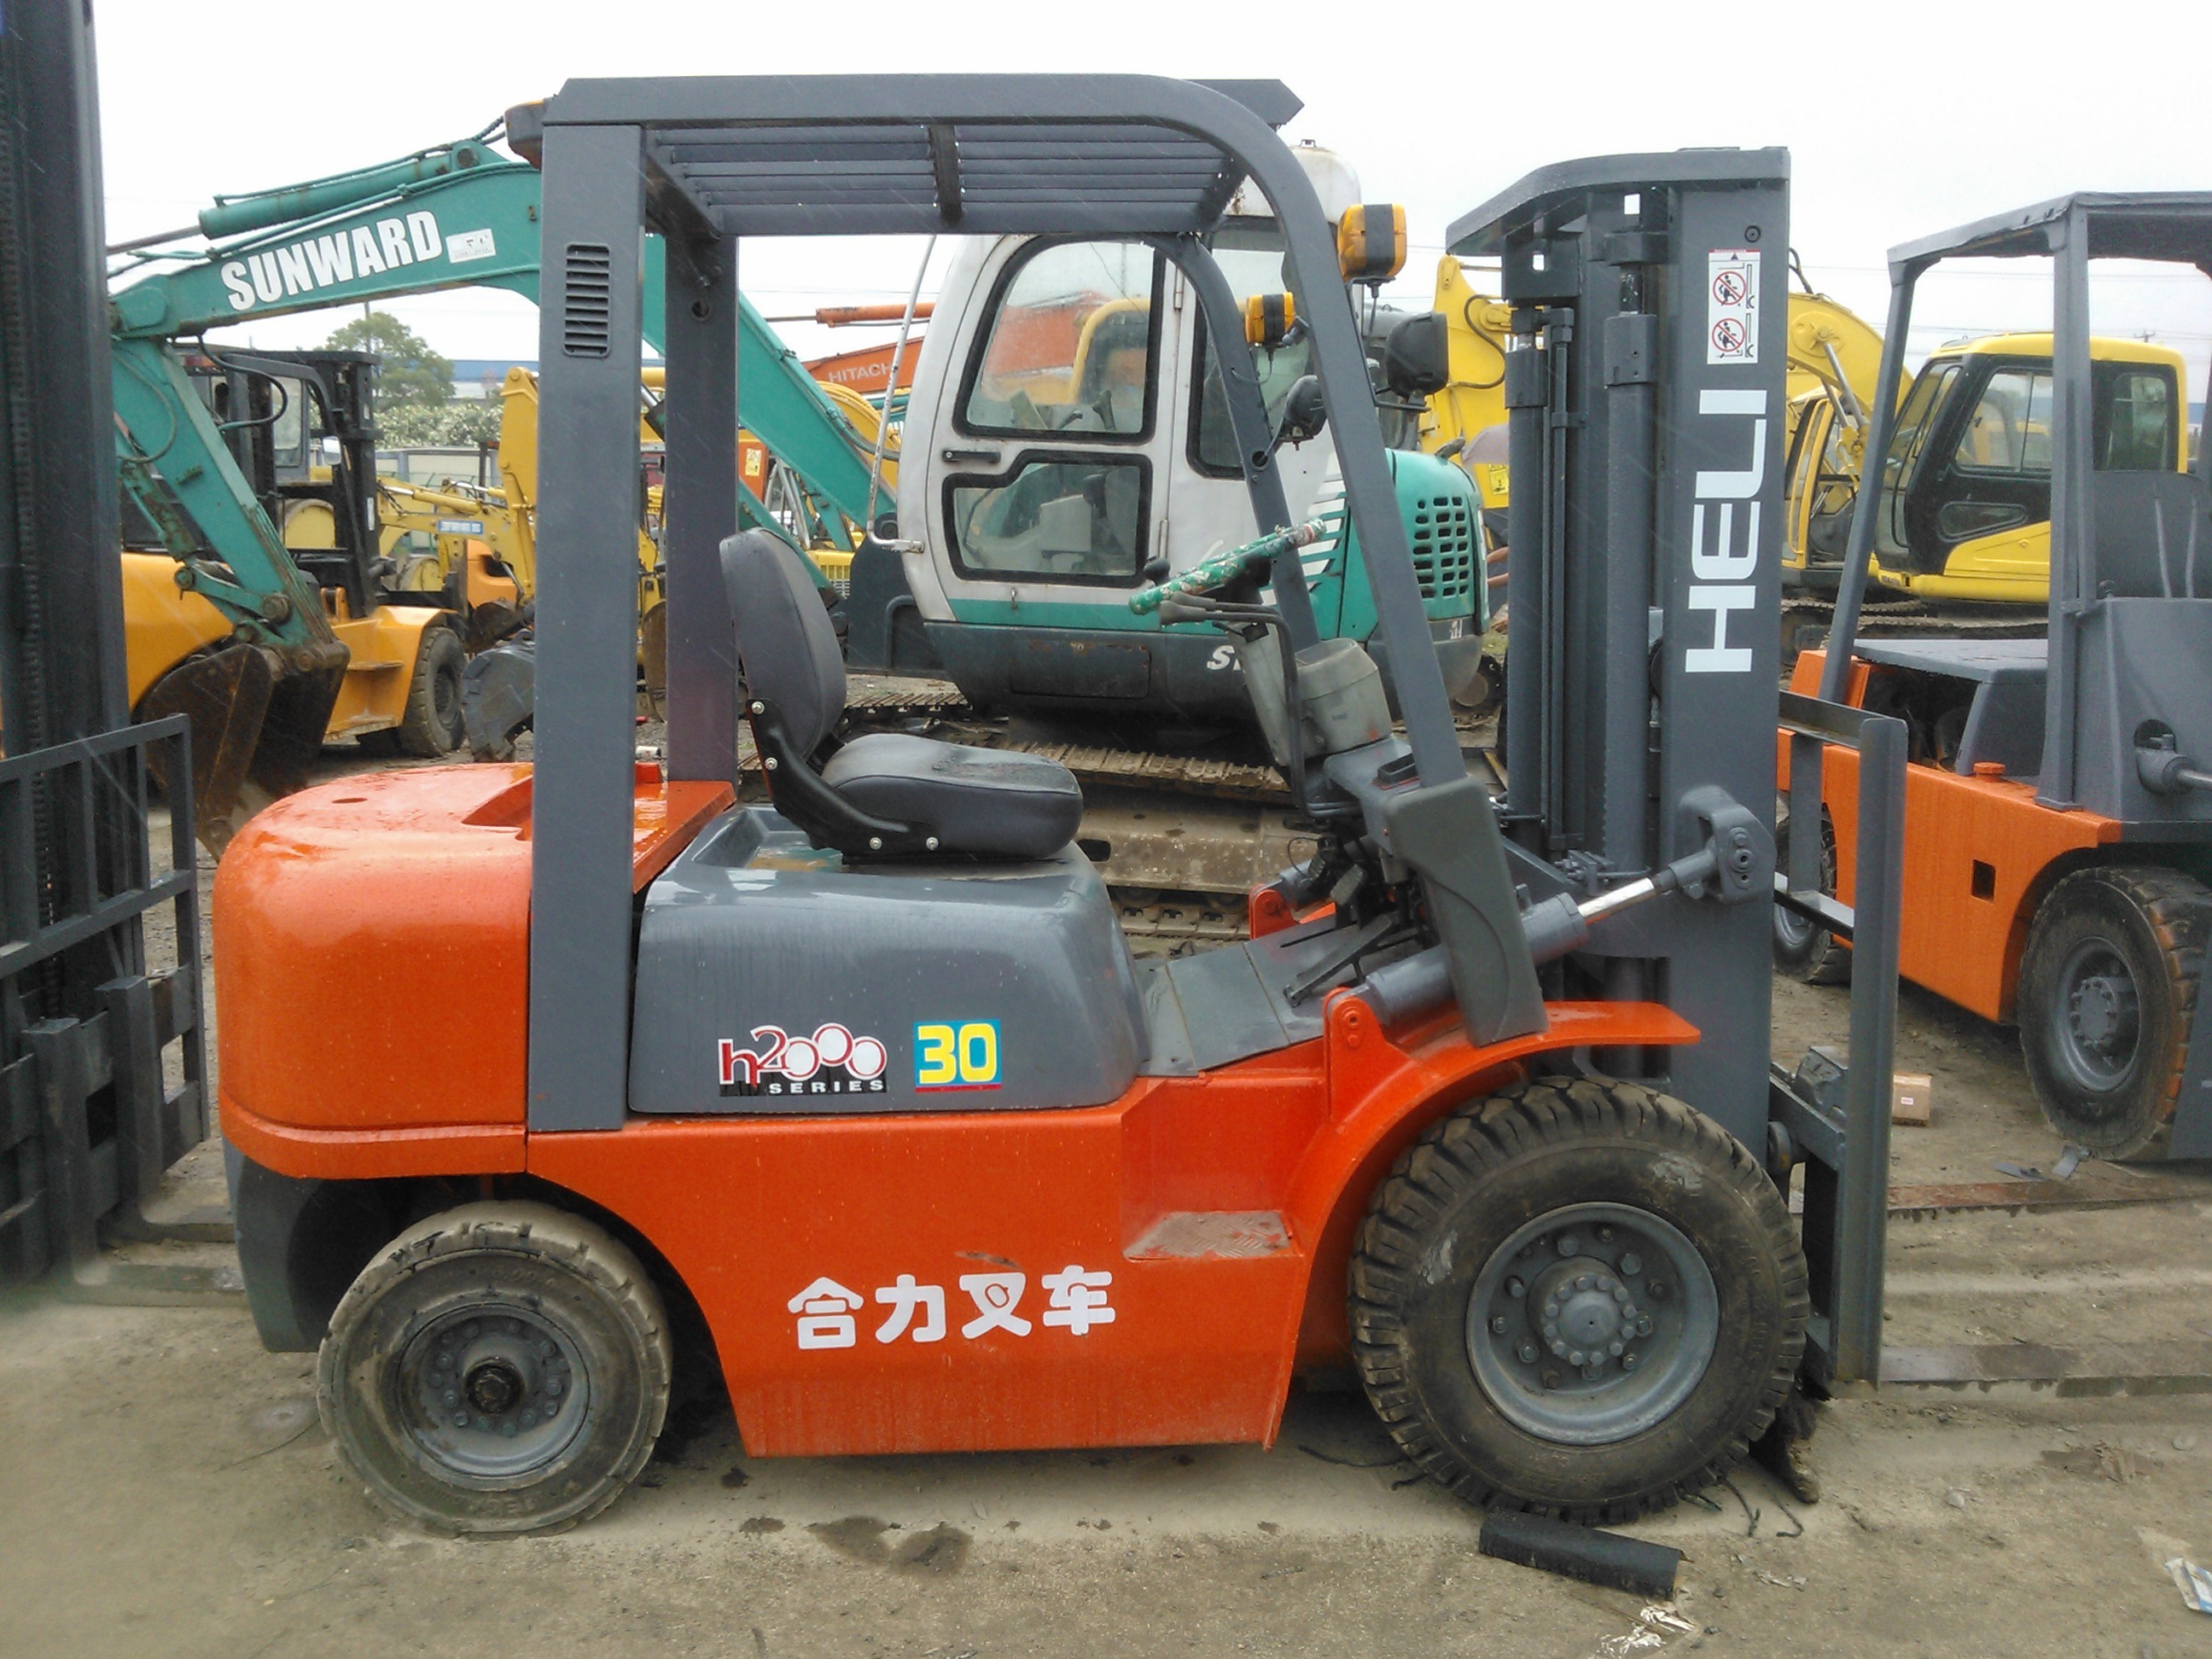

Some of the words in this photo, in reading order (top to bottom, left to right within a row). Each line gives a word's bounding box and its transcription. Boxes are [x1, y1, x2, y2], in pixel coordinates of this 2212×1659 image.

[221, 211, 442, 311] SUNWARD
[828, 363, 891, 383] HITACH
[1685, 390, 1767, 672] HELI
[769, 1080, 884, 1094] SERIES
[918, 1023, 997, 1085] 30
[787, 1265, 1116, 1349] 合力叉车
